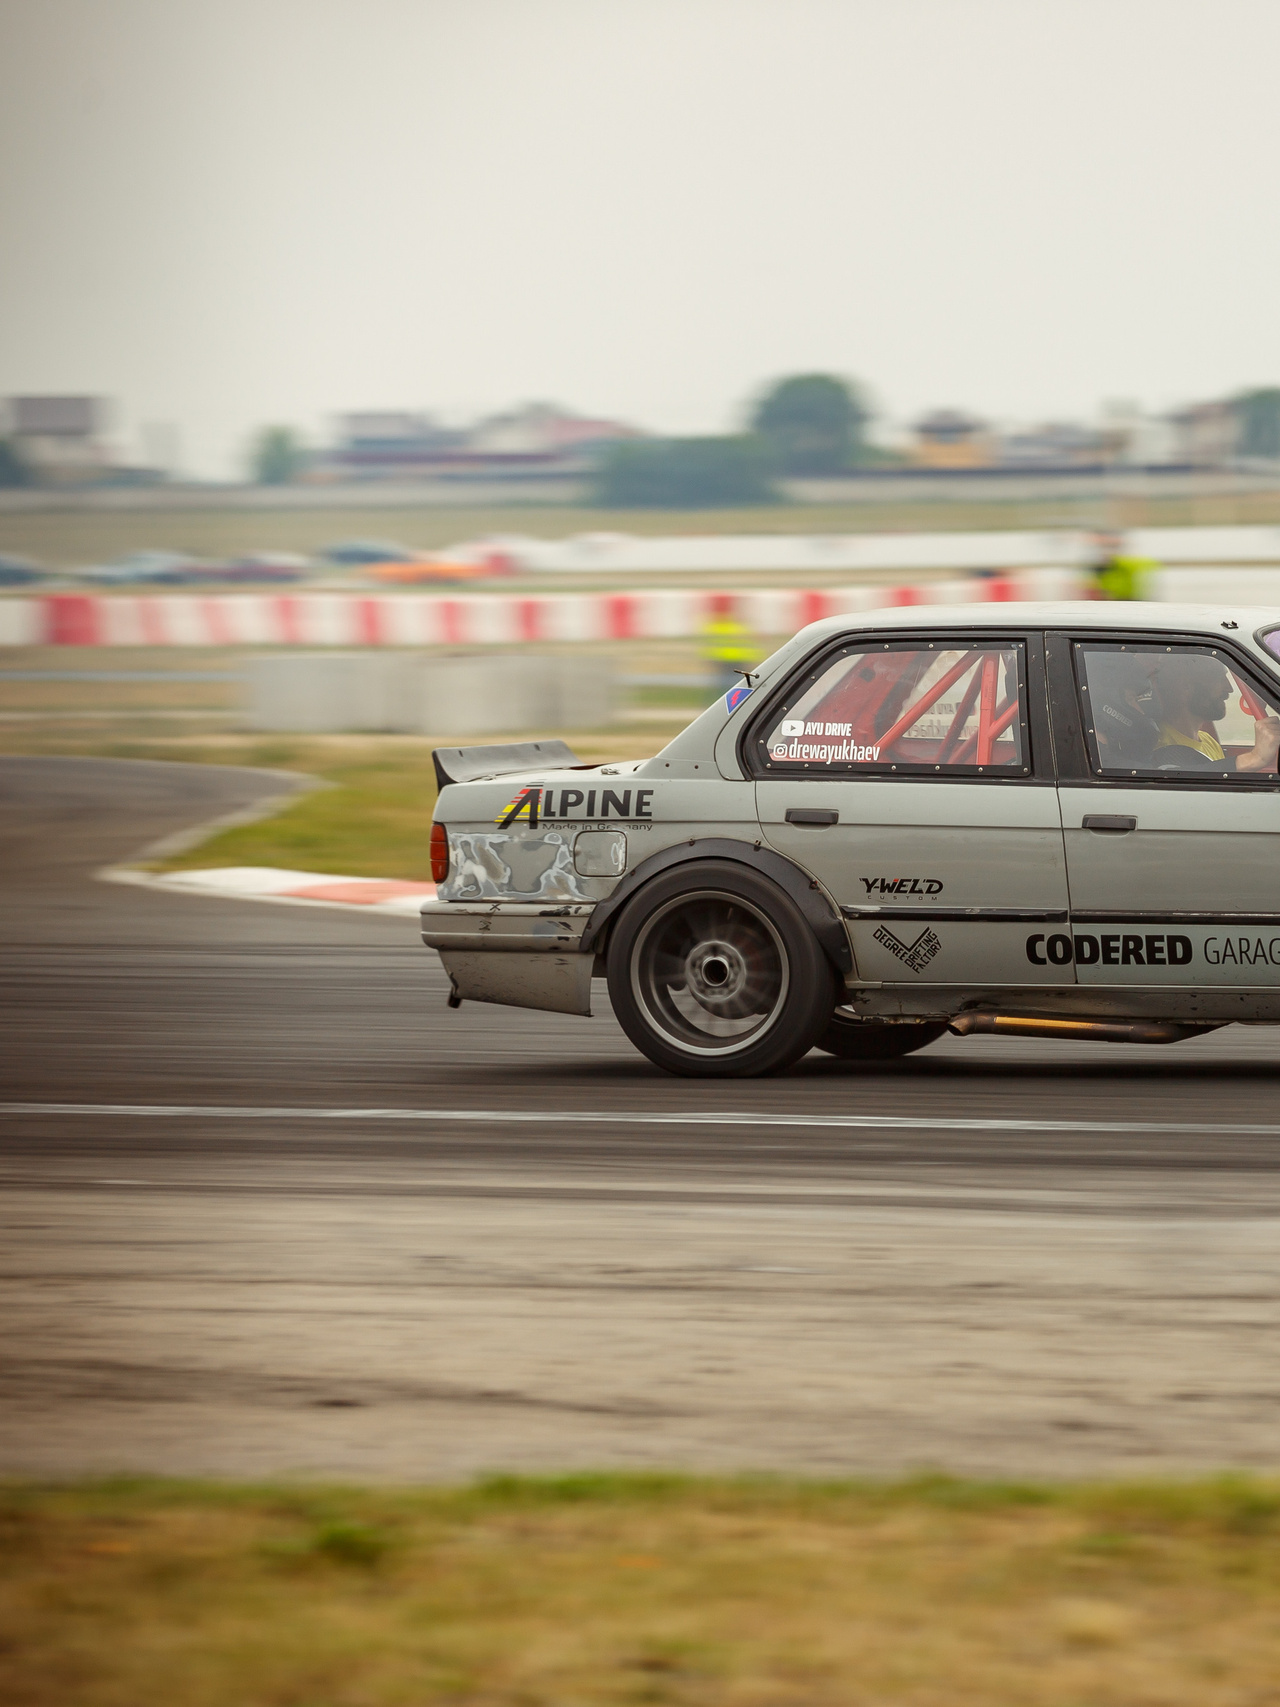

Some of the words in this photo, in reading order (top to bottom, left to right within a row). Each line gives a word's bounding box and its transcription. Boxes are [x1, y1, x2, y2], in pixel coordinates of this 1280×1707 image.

[804, 722, 824, 736] AYU
[825, 722, 853, 737] DRIVE
[497, 788, 654, 830] ALPINE
[542, 823, 578, 831] Made
[582, 823, 592, 831] in
[872, 928, 909, 961] DEGREE
[904, 930, 938, 968] DRIFTING
[912, 939, 942, 974] FACTORY
[1026, 933, 1193, 966] CODERED
